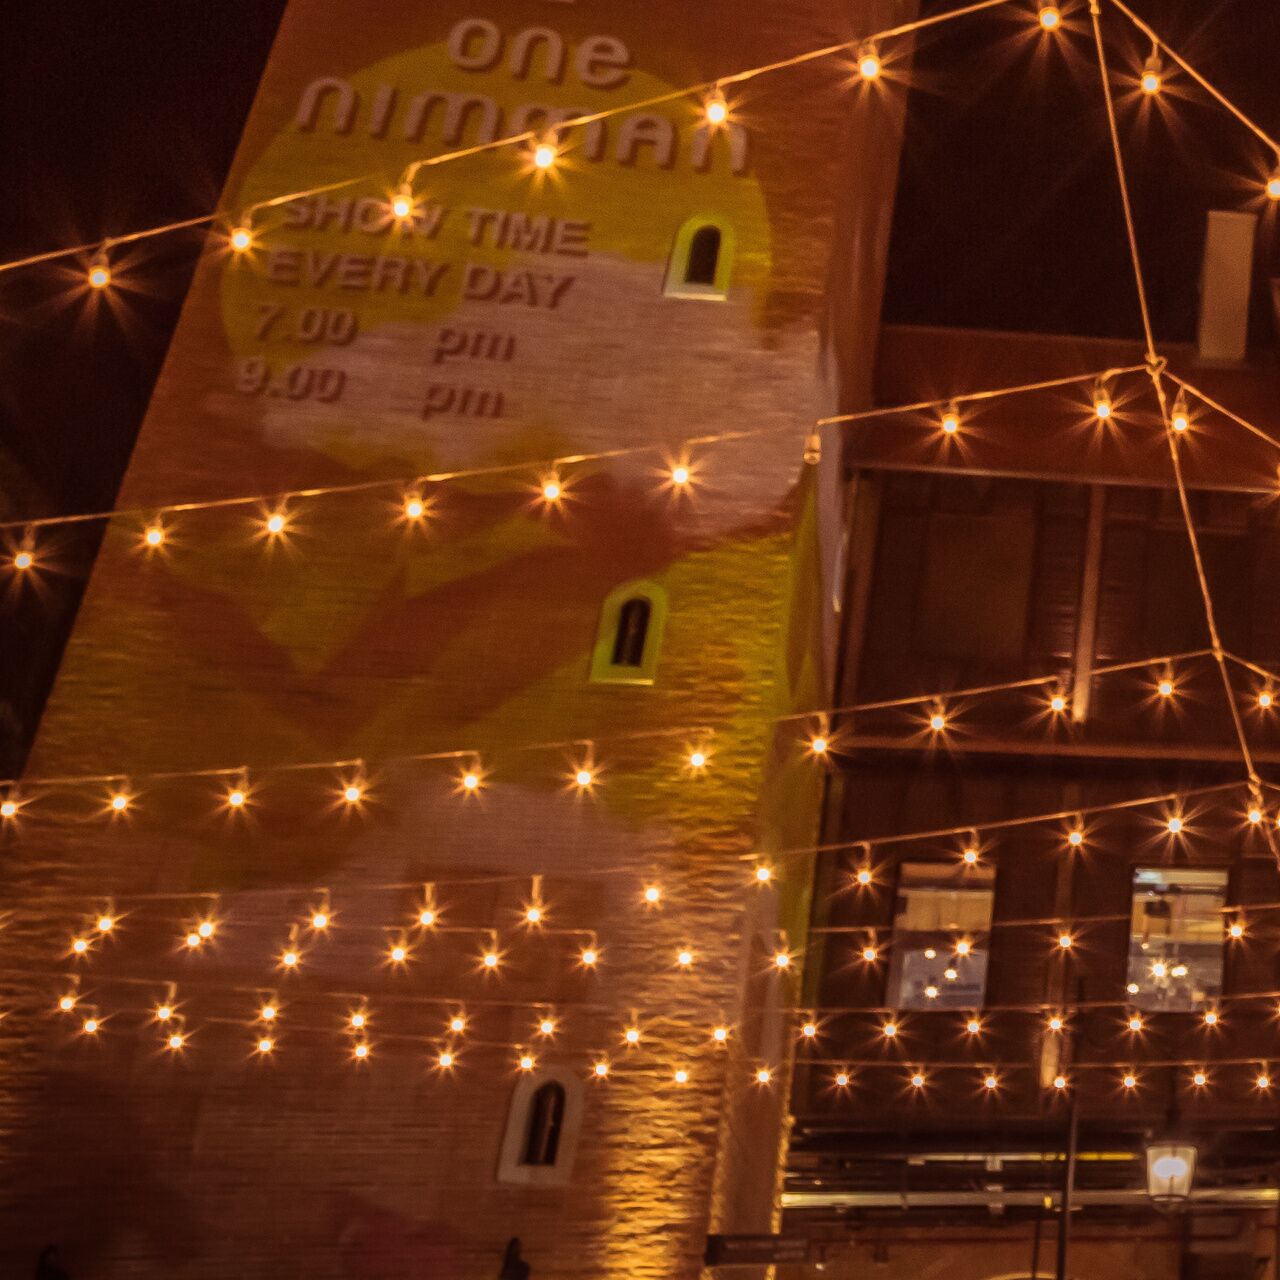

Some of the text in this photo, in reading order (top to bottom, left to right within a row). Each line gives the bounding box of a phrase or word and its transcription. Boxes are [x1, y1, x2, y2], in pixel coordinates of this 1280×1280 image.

[447, 18, 632, 88] one
[283, 194, 592, 258] SHOW TIME
[263, 246, 577, 310] EVERY DAY
[255, 301, 517, 365] 7.00 pm
[234, 358, 506, 421] 9.00 pm
